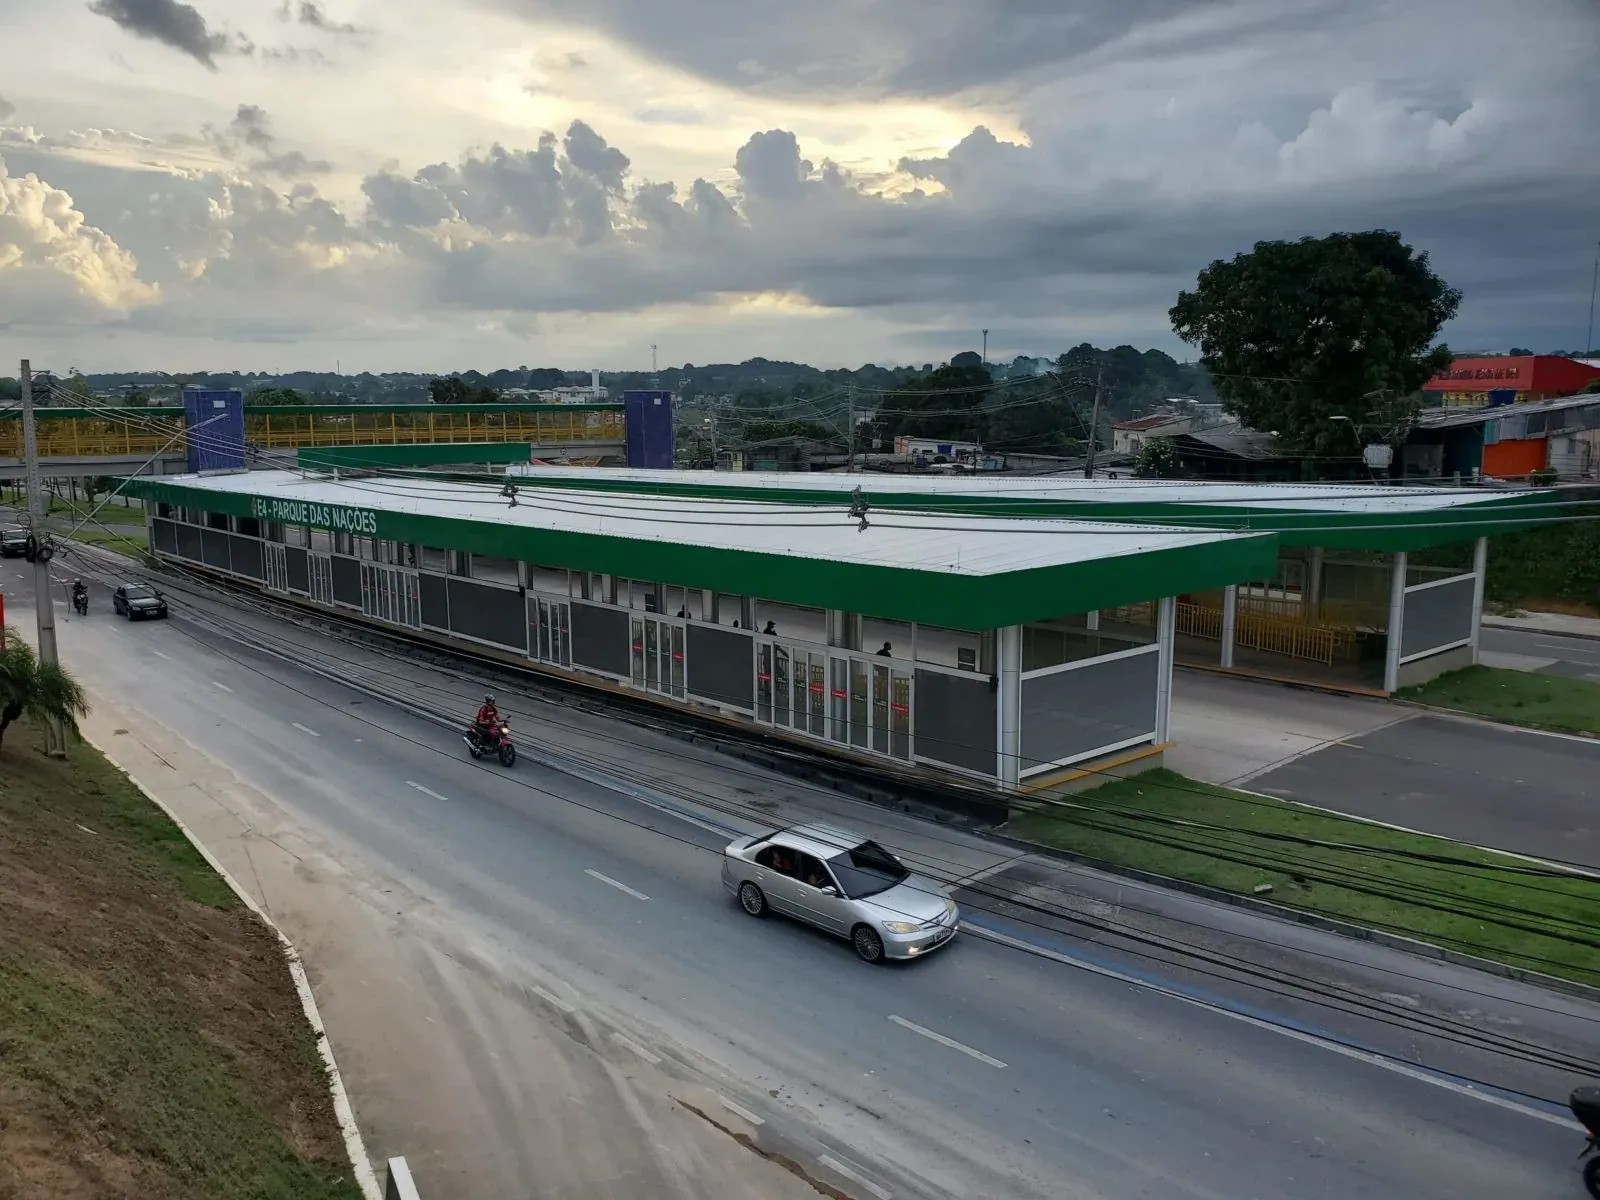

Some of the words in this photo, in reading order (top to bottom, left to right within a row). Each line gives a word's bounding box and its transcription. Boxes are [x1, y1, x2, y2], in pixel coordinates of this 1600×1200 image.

[257, 499, 267, 517] E4
[273, 501, 308, 523] PARQUE
[309, 504, 331, 527] DAS
[332, 507, 377, 534] NAÇÕES
